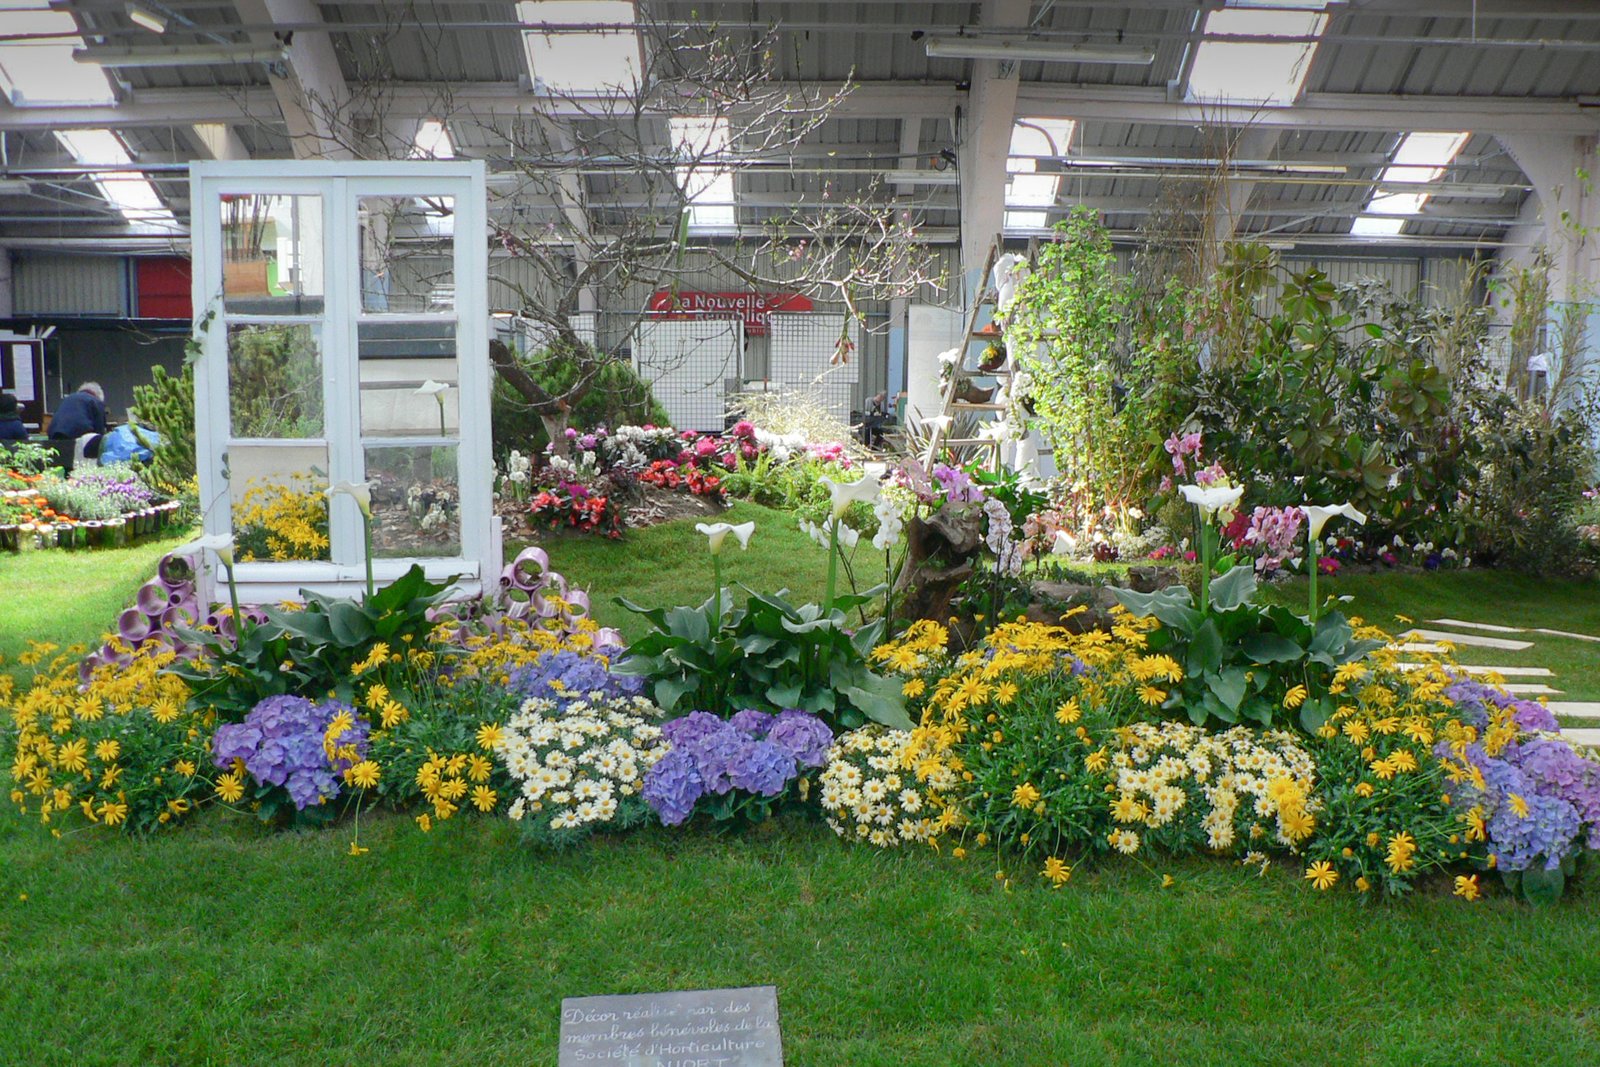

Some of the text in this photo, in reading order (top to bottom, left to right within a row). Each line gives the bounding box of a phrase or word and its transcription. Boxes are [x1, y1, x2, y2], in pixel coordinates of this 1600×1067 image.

[695, 294, 765, 309] Nouvelle
[564, 1008, 620, 1024] Décor
[723, 1000, 751, 1014] des
[566, 1024, 645, 1044] membres
[651, 1018, 730, 1038] bénévoles
[735, 1018, 753, 1031] de
[575, 1037, 765, 1061] Société d'Horticulture
